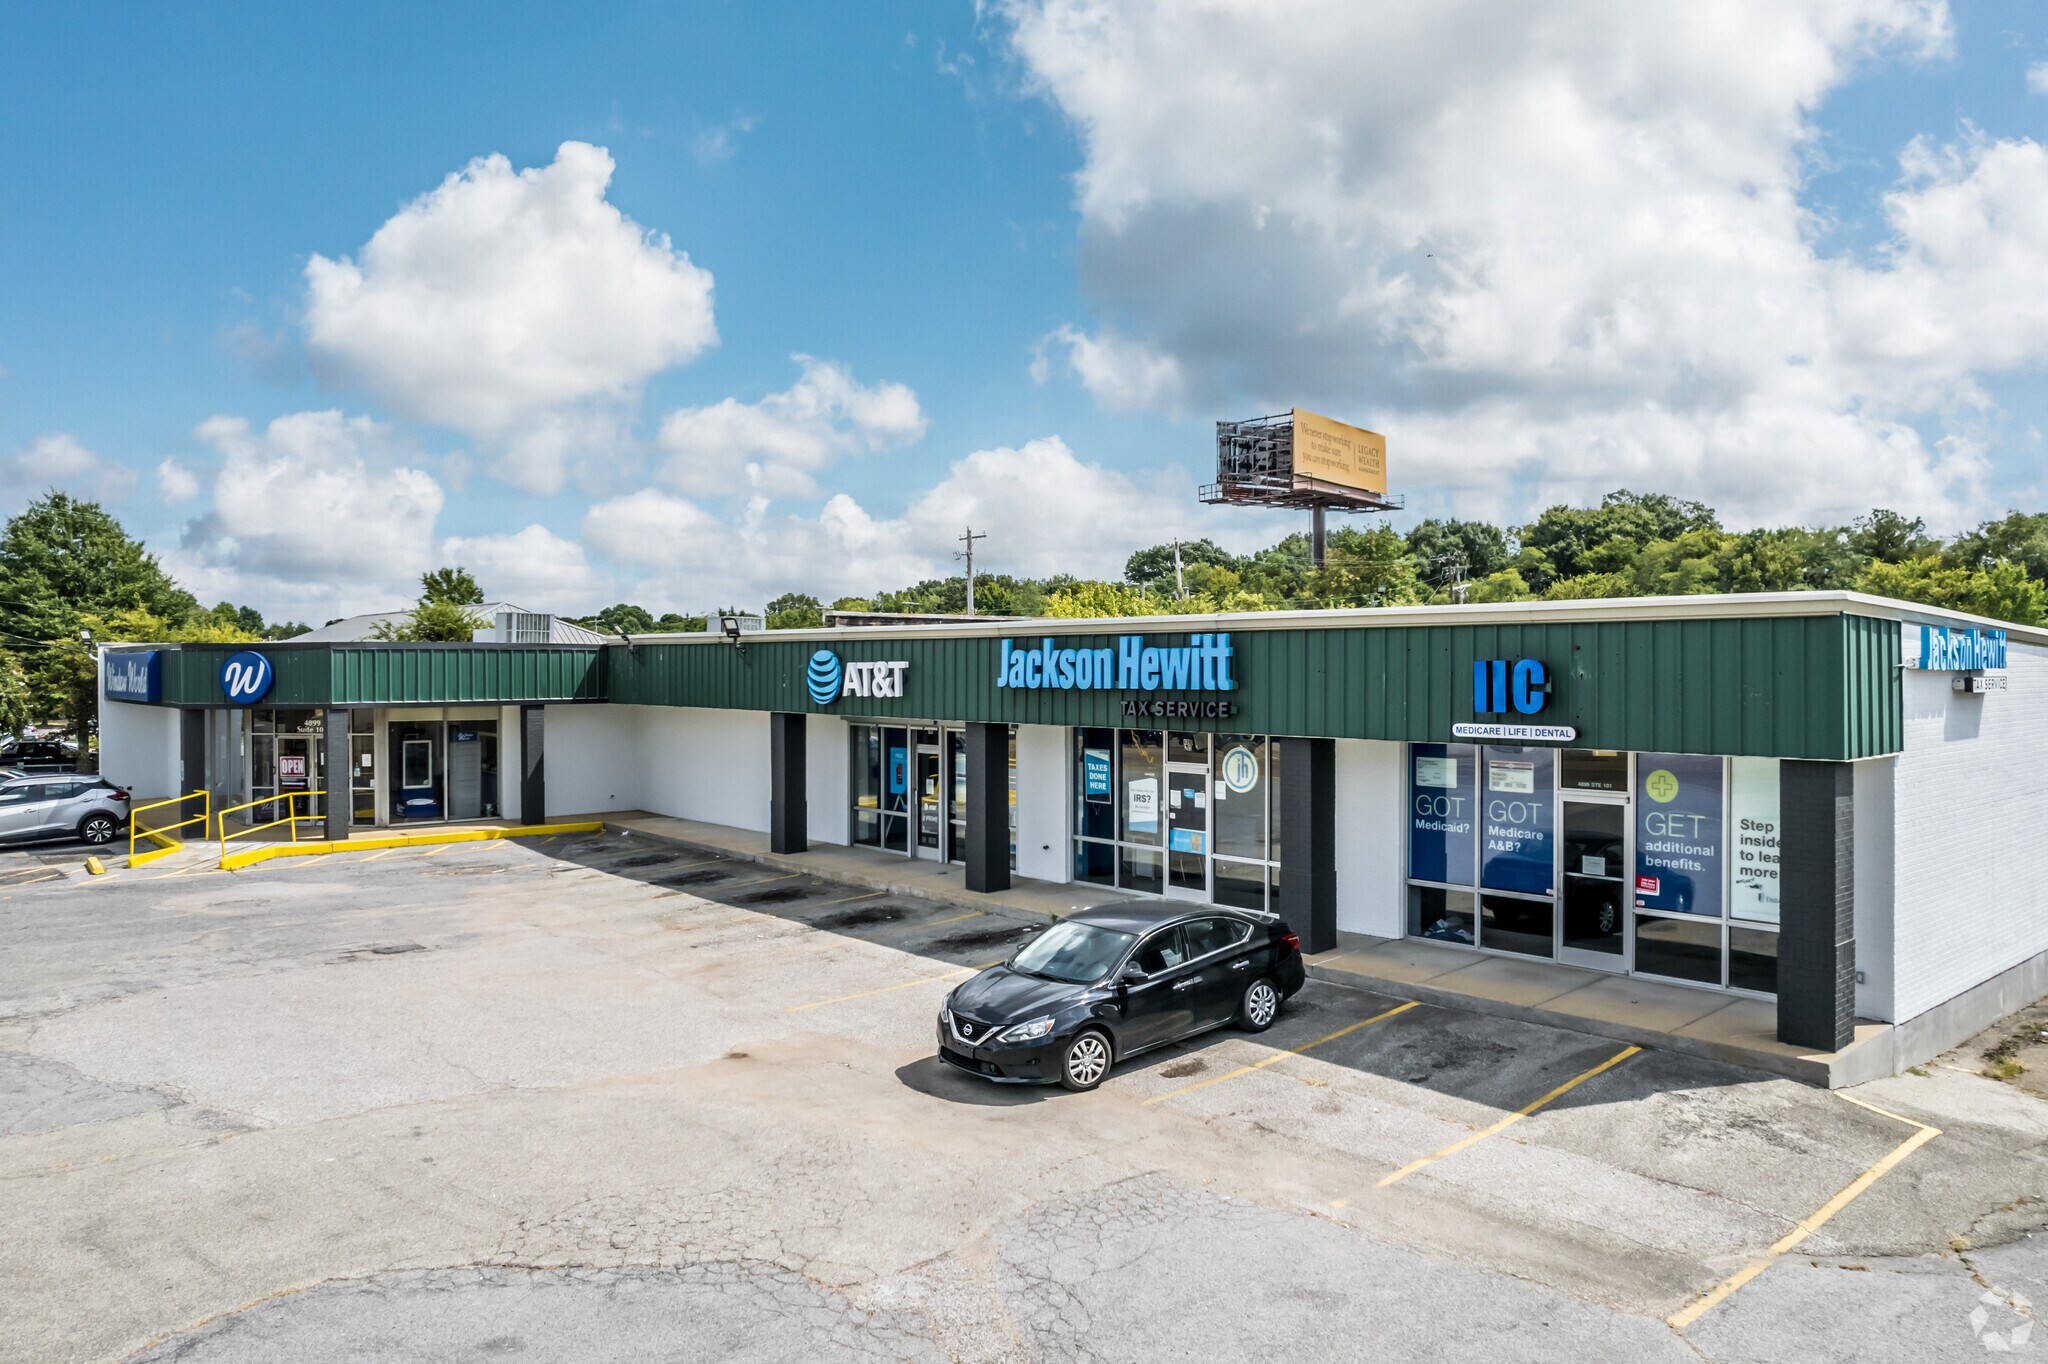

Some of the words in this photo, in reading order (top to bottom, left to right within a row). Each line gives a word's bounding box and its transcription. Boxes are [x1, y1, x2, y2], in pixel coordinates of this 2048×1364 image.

[1300, 421, 1309, 435] We
[1311, 442, 1317, 450] to
[1358, 444, 1379, 458] LEGACY
[1358, 456, 1380, 468] WEALTH
[1922, 625, 1972, 671] Jackson
[1973, 628, 2007, 670] Hewitt
[997, 638, 1117, 690] Jackson
[1118, 633, 1234, 691] Hewitt
[106, 661, 127, 692] Window
[128, 660, 148, 694] World
[224, 660, 266, 698] W
[843, 661, 909, 698] AT&T
[1473, 658, 1546, 715] IIC
[1973, 679, 1983, 691] TAX
[1984, 678, 2006, 690] SERVICE
[1119, 700, 1152, 716] TAX
[1153, 701, 1233, 718] SERVICE
[1455, 726, 1501, 736] MEDICARE
[1508, 728, 1528, 737] LIFE
[1534, 728, 1572, 738] DENTAL
[282, 760, 304, 774] OPEN
[1088, 762, 1108, 772] TAXES
[1089, 772, 1106, 781] DONE
[1090, 782, 1106, 790] HERE
[1133, 793, 1152, 803] IRS?
[1416, 794, 1466, 818] GOT
[1488, 800, 1543, 824] GOT
[1415, 819, 1470, 833] Medicaid?
[1645, 812, 1706, 838] GET
[1740, 818, 1774, 834] Step
[1488, 825, 1544, 840] Medicare
[1488, 840, 1521, 852] A&B?
[1645, 840, 1714, 856] additional
[1740, 850, 1754, 861] to
[1645, 856, 1706, 872] benefits.
[1740, 866, 1778, 879] more
